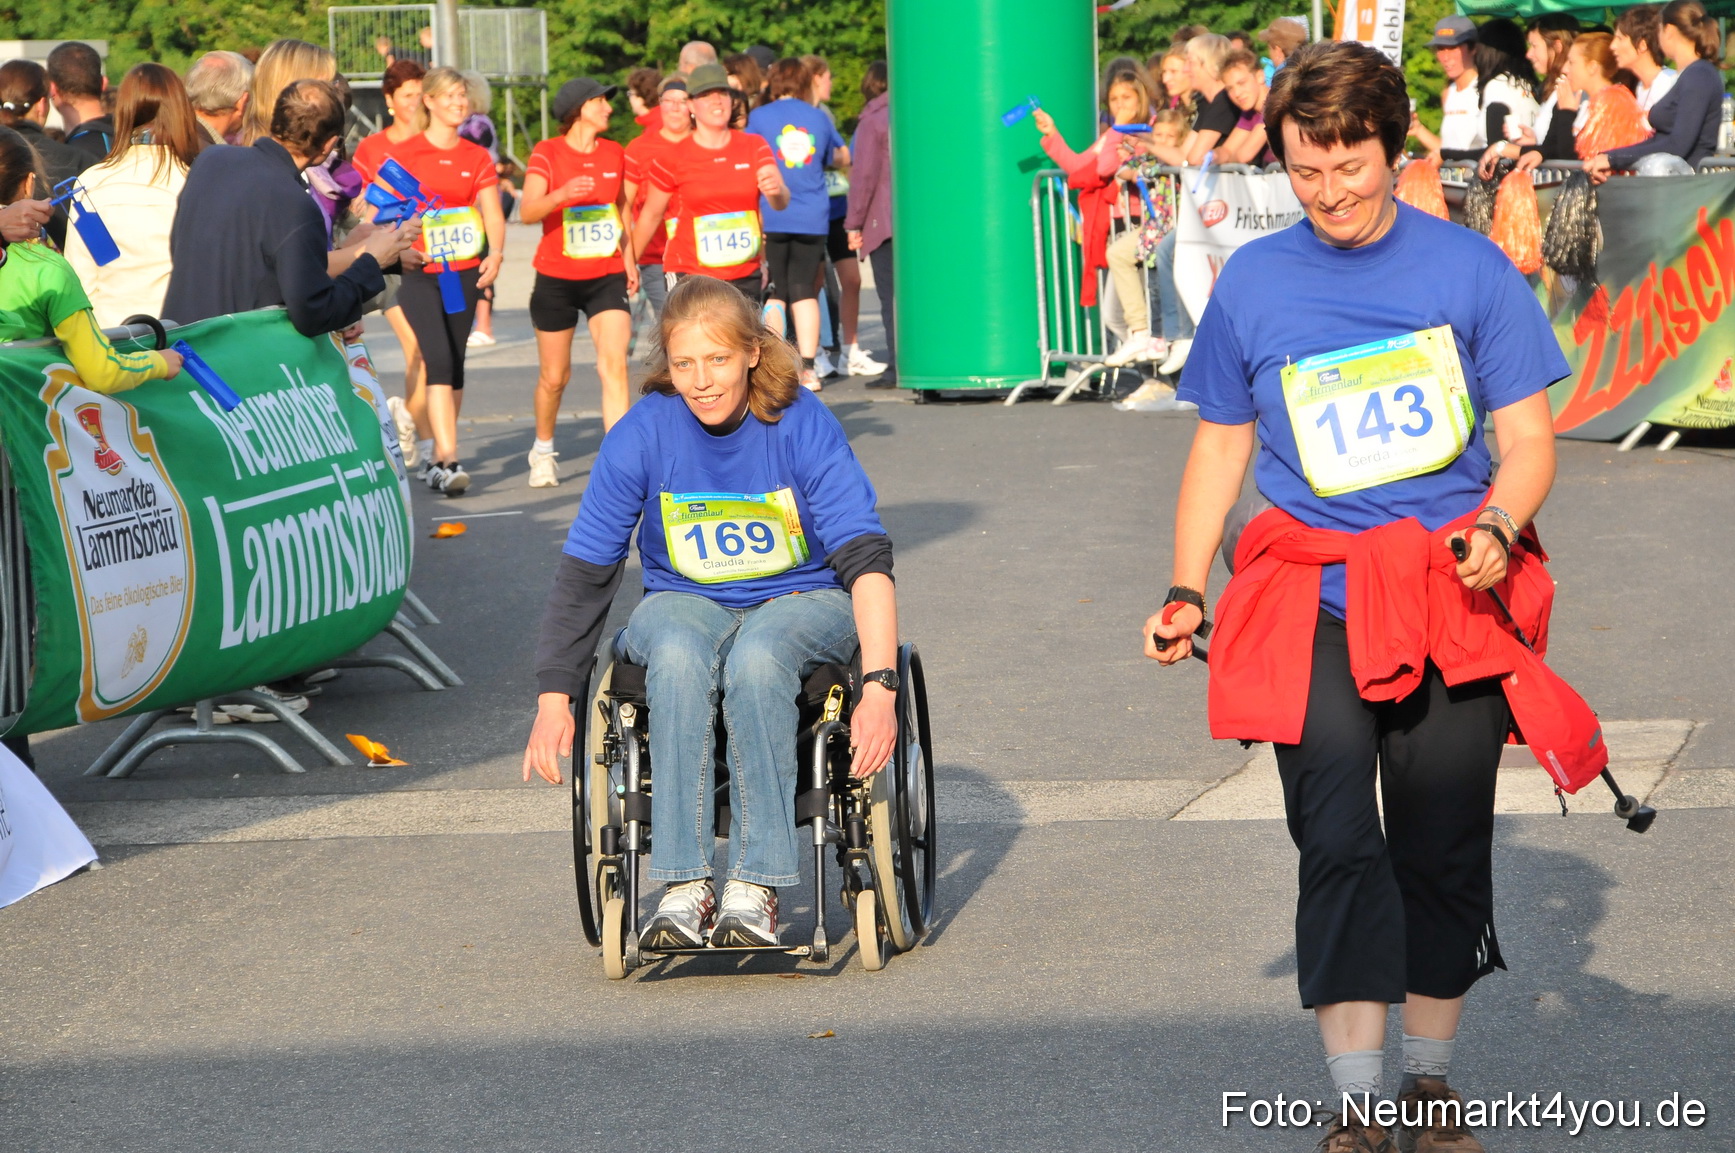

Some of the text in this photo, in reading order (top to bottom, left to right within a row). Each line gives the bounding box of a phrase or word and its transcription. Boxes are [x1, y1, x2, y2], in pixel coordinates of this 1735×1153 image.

[428, 225, 474, 246] 1146
[568, 222, 614, 244] 1153
[700, 231, 751, 252] 1145
[1310, 374, 1363, 396] firmenlauf
[189, 363, 358, 480] Neumarkter
[1316, 384, 1434, 456] 143
[1348, 450, 1390, 468] Gerda
[83, 478, 157, 521] Neumarkter
[681, 509, 723, 520] firmenlauf
[76, 509, 178, 571] Lammsbräu
[203, 458, 405, 650] Lammsbräu
[684, 521, 776, 560] 169
[703, 557, 745, 569] Claudia
[90, 575, 184, 615] Das feine ökologische Bier
